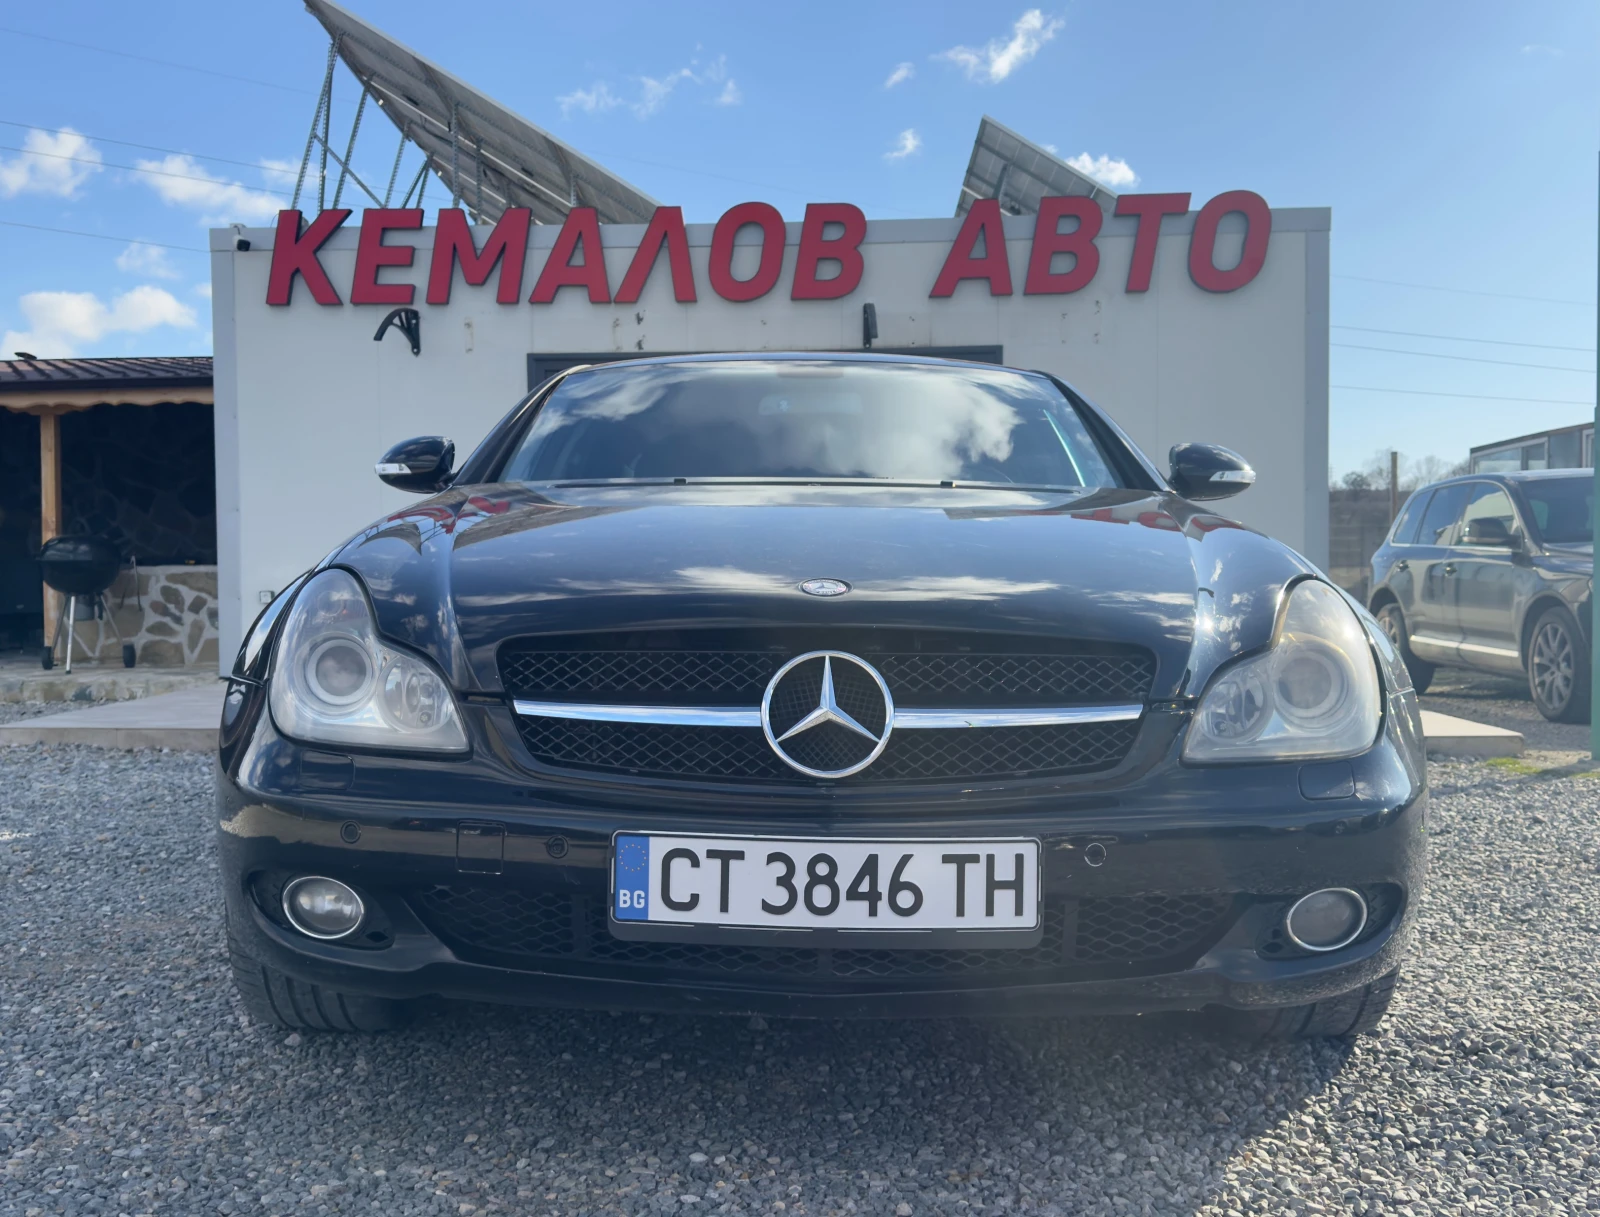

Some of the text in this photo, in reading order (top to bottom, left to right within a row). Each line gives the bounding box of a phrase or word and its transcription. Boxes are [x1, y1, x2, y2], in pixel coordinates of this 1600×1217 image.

[266, 190, 1272, 306] КЕМАЛОВ АВТО
[618, 889, 646, 909] BG
[661, 847, 1025, 918] CT 3846 TH
